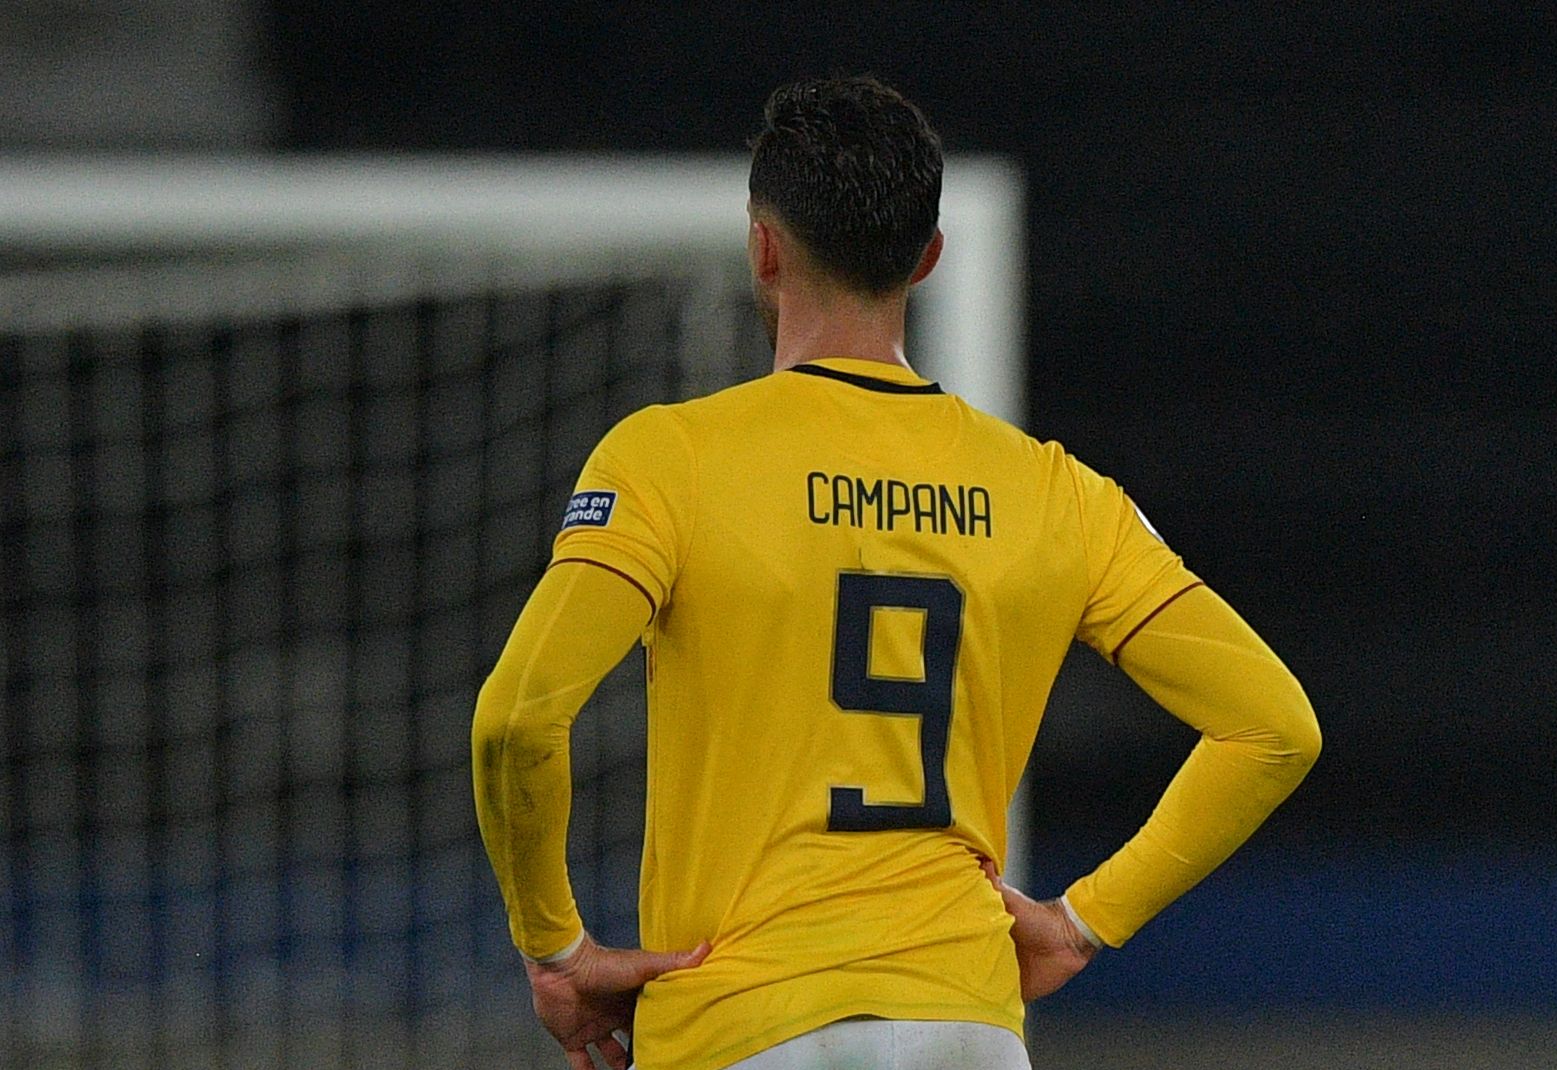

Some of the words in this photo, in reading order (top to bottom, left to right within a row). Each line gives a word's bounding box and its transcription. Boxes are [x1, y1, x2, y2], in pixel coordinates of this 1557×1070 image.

[590, 496, 610, 508] en
[807, 471, 991, 538] CAMPANA
[826, 571, 966, 832] 9
